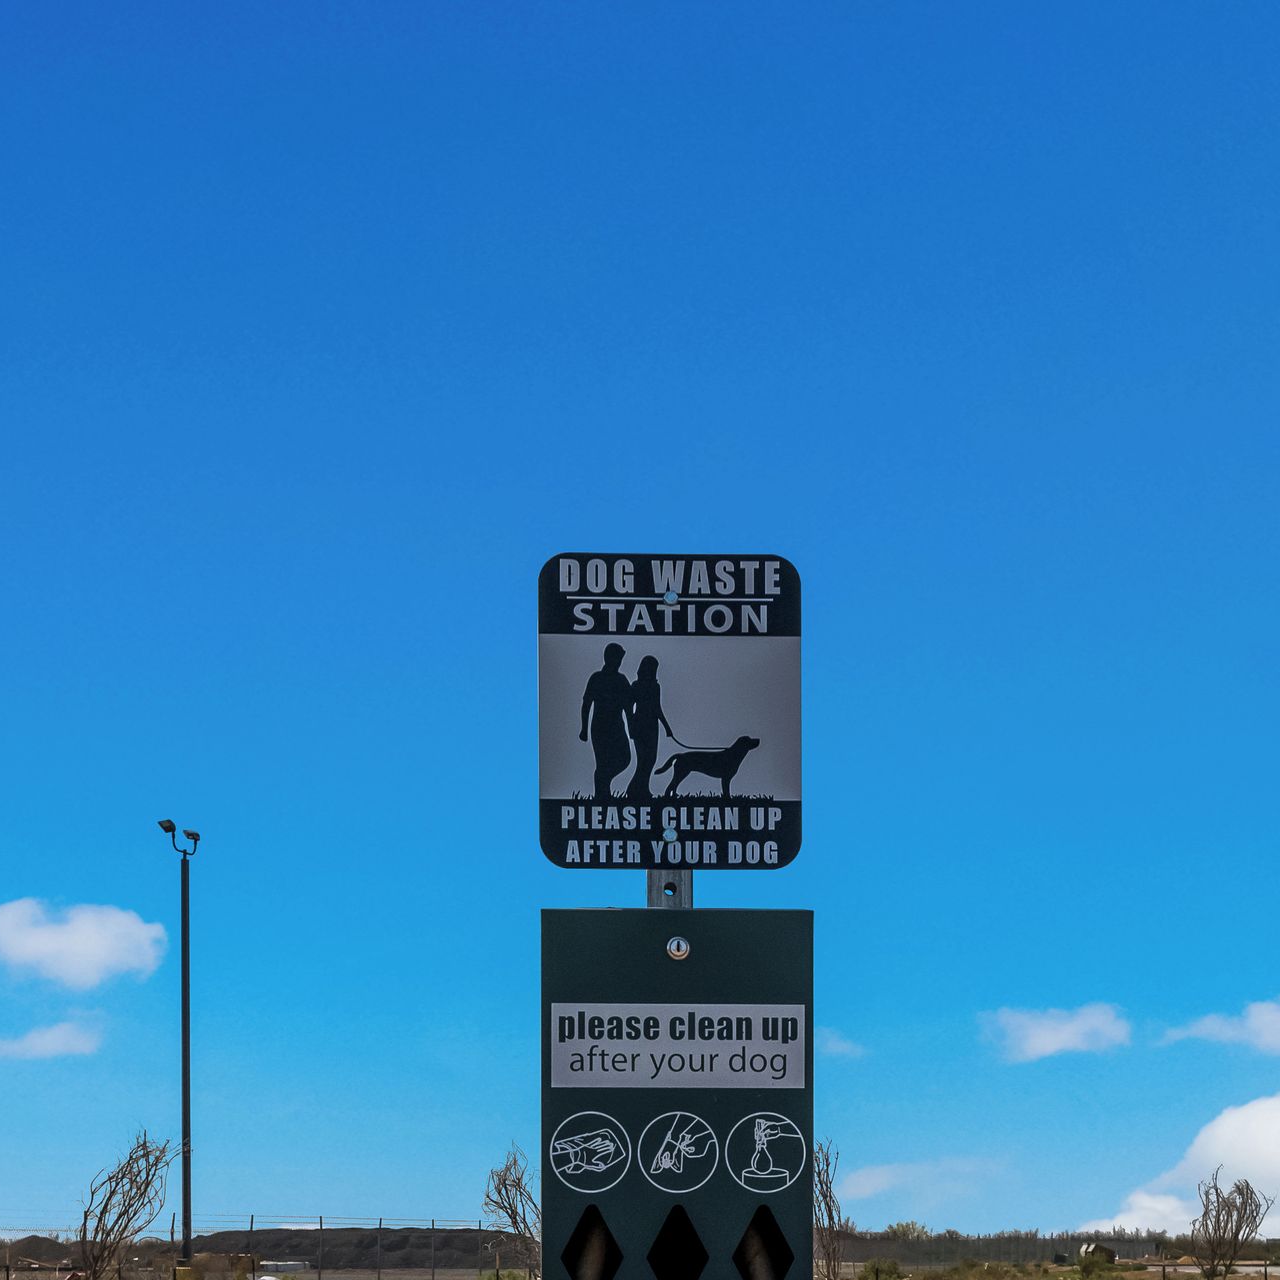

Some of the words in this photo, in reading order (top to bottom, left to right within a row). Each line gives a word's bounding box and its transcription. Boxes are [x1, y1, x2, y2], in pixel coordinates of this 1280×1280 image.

[559, 558, 635, 594] DOG
[651, 560, 781, 595] WASTE
[572, 602, 768, 633] STATION
[561, 806, 651, 830] PLEASE
[661, 807, 739, 830] CLEAN
[750, 807, 782, 830] UP
[565, 840, 641, 863] AFTER
[651, 840, 718, 864] YOUR
[728, 841, 779, 864] DOG
[558, 1011, 661, 1043] please
[669, 1011, 753, 1041] clean
[762, 1017, 798, 1044] up
[570, 1045, 641, 1073] after
[649, 1052, 719, 1080] your
[728, 1046, 788, 1080] dog
